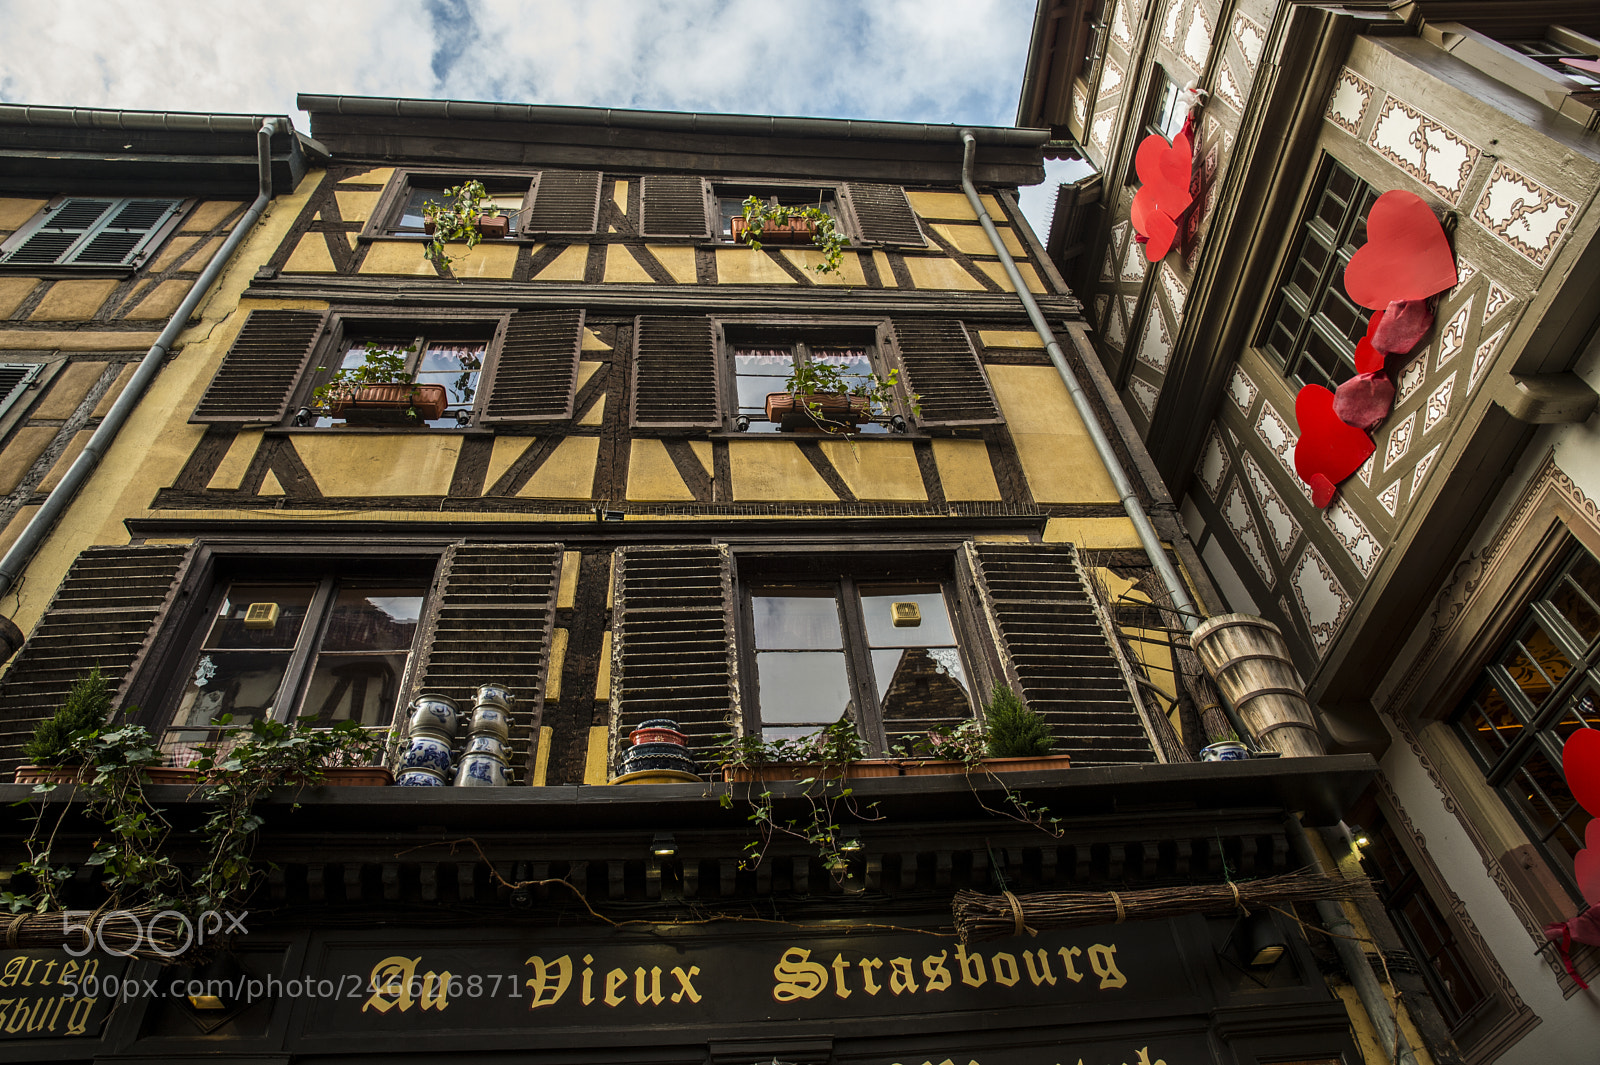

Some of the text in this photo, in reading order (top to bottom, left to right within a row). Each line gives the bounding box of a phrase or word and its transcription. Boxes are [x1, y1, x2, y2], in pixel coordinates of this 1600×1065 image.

[362, 943, 1128, 1014] Au Vieux Strasbourg
